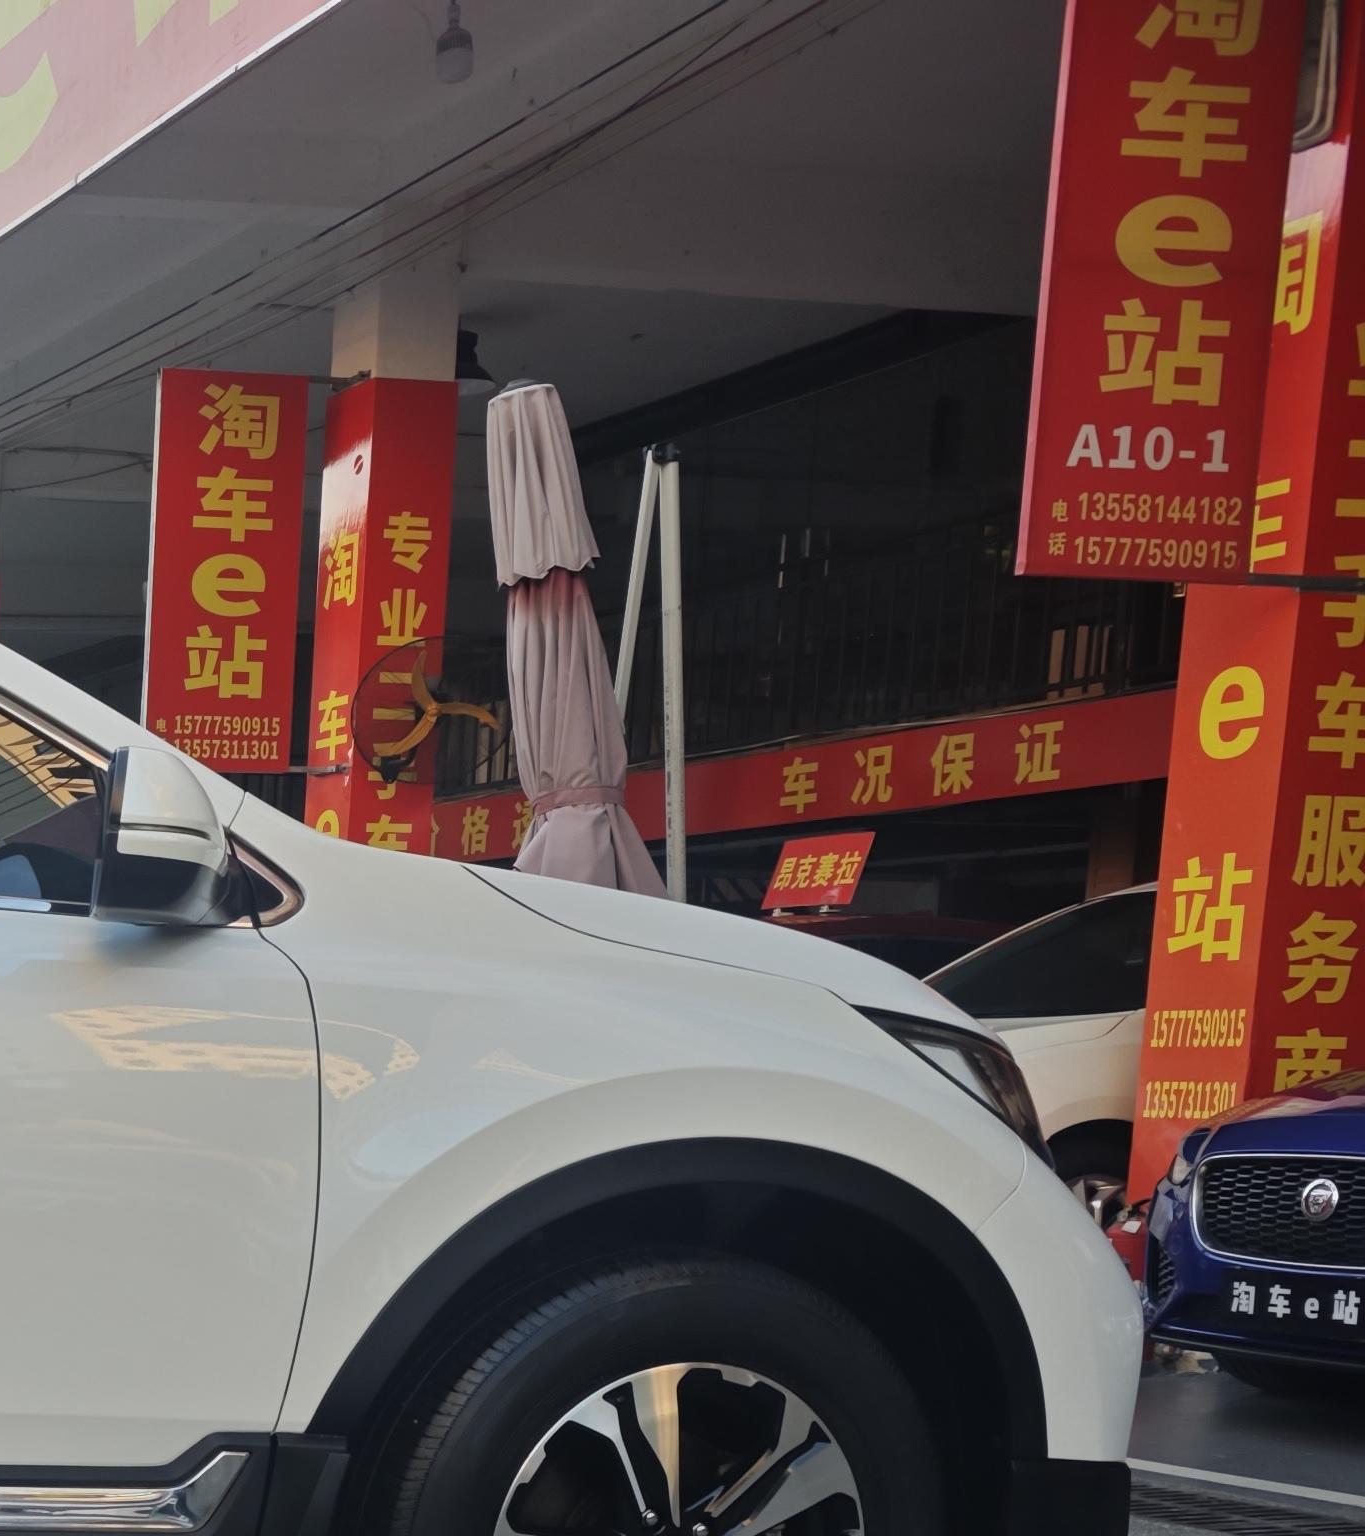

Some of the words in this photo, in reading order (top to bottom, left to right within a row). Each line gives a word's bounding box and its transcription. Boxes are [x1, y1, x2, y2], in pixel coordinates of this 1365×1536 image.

[1065, 423, 1230, 473] A10-1
[1078, 491, 1243, 526] 13558144182
[184, 384, 280, 699] 淘车e站
[1073, 536, 1238, 570] 15777590915
[173, 715, 281, 737] 15777590915
[779, 720, 1065, 815] 车况保证
[772, 851, 862, 891] 昂克赛拉
[1150, 1008, 1247, 1048] 15777590915
[1142, 1081, 1237, 1120] 13557311301
[1230, 1281, 1361, 1325] 淘车e站
